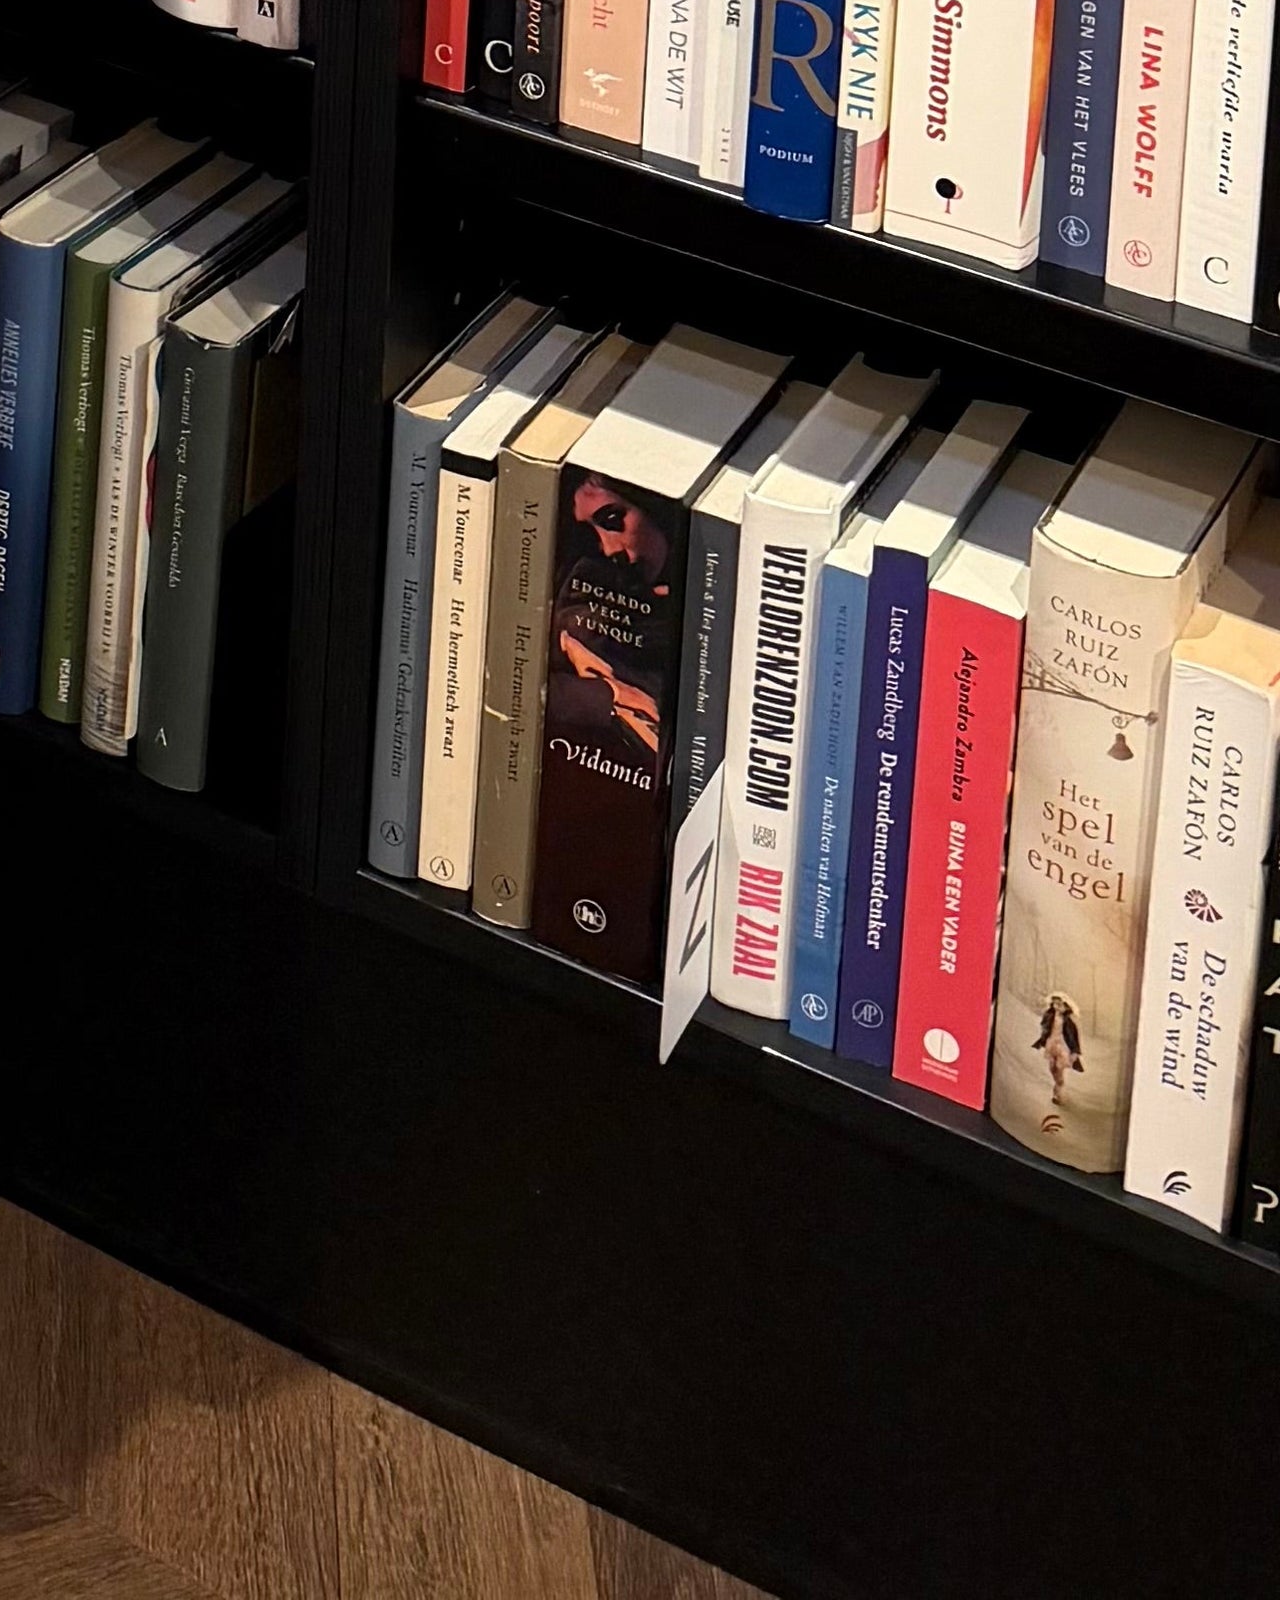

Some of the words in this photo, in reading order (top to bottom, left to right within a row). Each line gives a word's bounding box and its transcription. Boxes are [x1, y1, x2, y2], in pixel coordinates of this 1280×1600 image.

[759, 144, 814, 165] PODIUM
[1049, 594, 1142, 640] CARLOS
[1053, 643, 1131, 690] ZAFÓN
[1063, 628, 1120, 662] RUIZ
[746, 545, 808, 812] VERLORENZOON.COM
[548, 736, 652, 792] Vidamía
[1058, 777, 1101, 812] Het
[1043, 798, 1115, 847] spel
[1027, 843, 1125, 904] engel
[1041, 832, 1077, 862] van
[1082, 843, 1113, 870] de
[738, 860, 783, 907] RIK
[678, 839, 715, 976] Z
[732, 913, 777, 981] ZAAL
